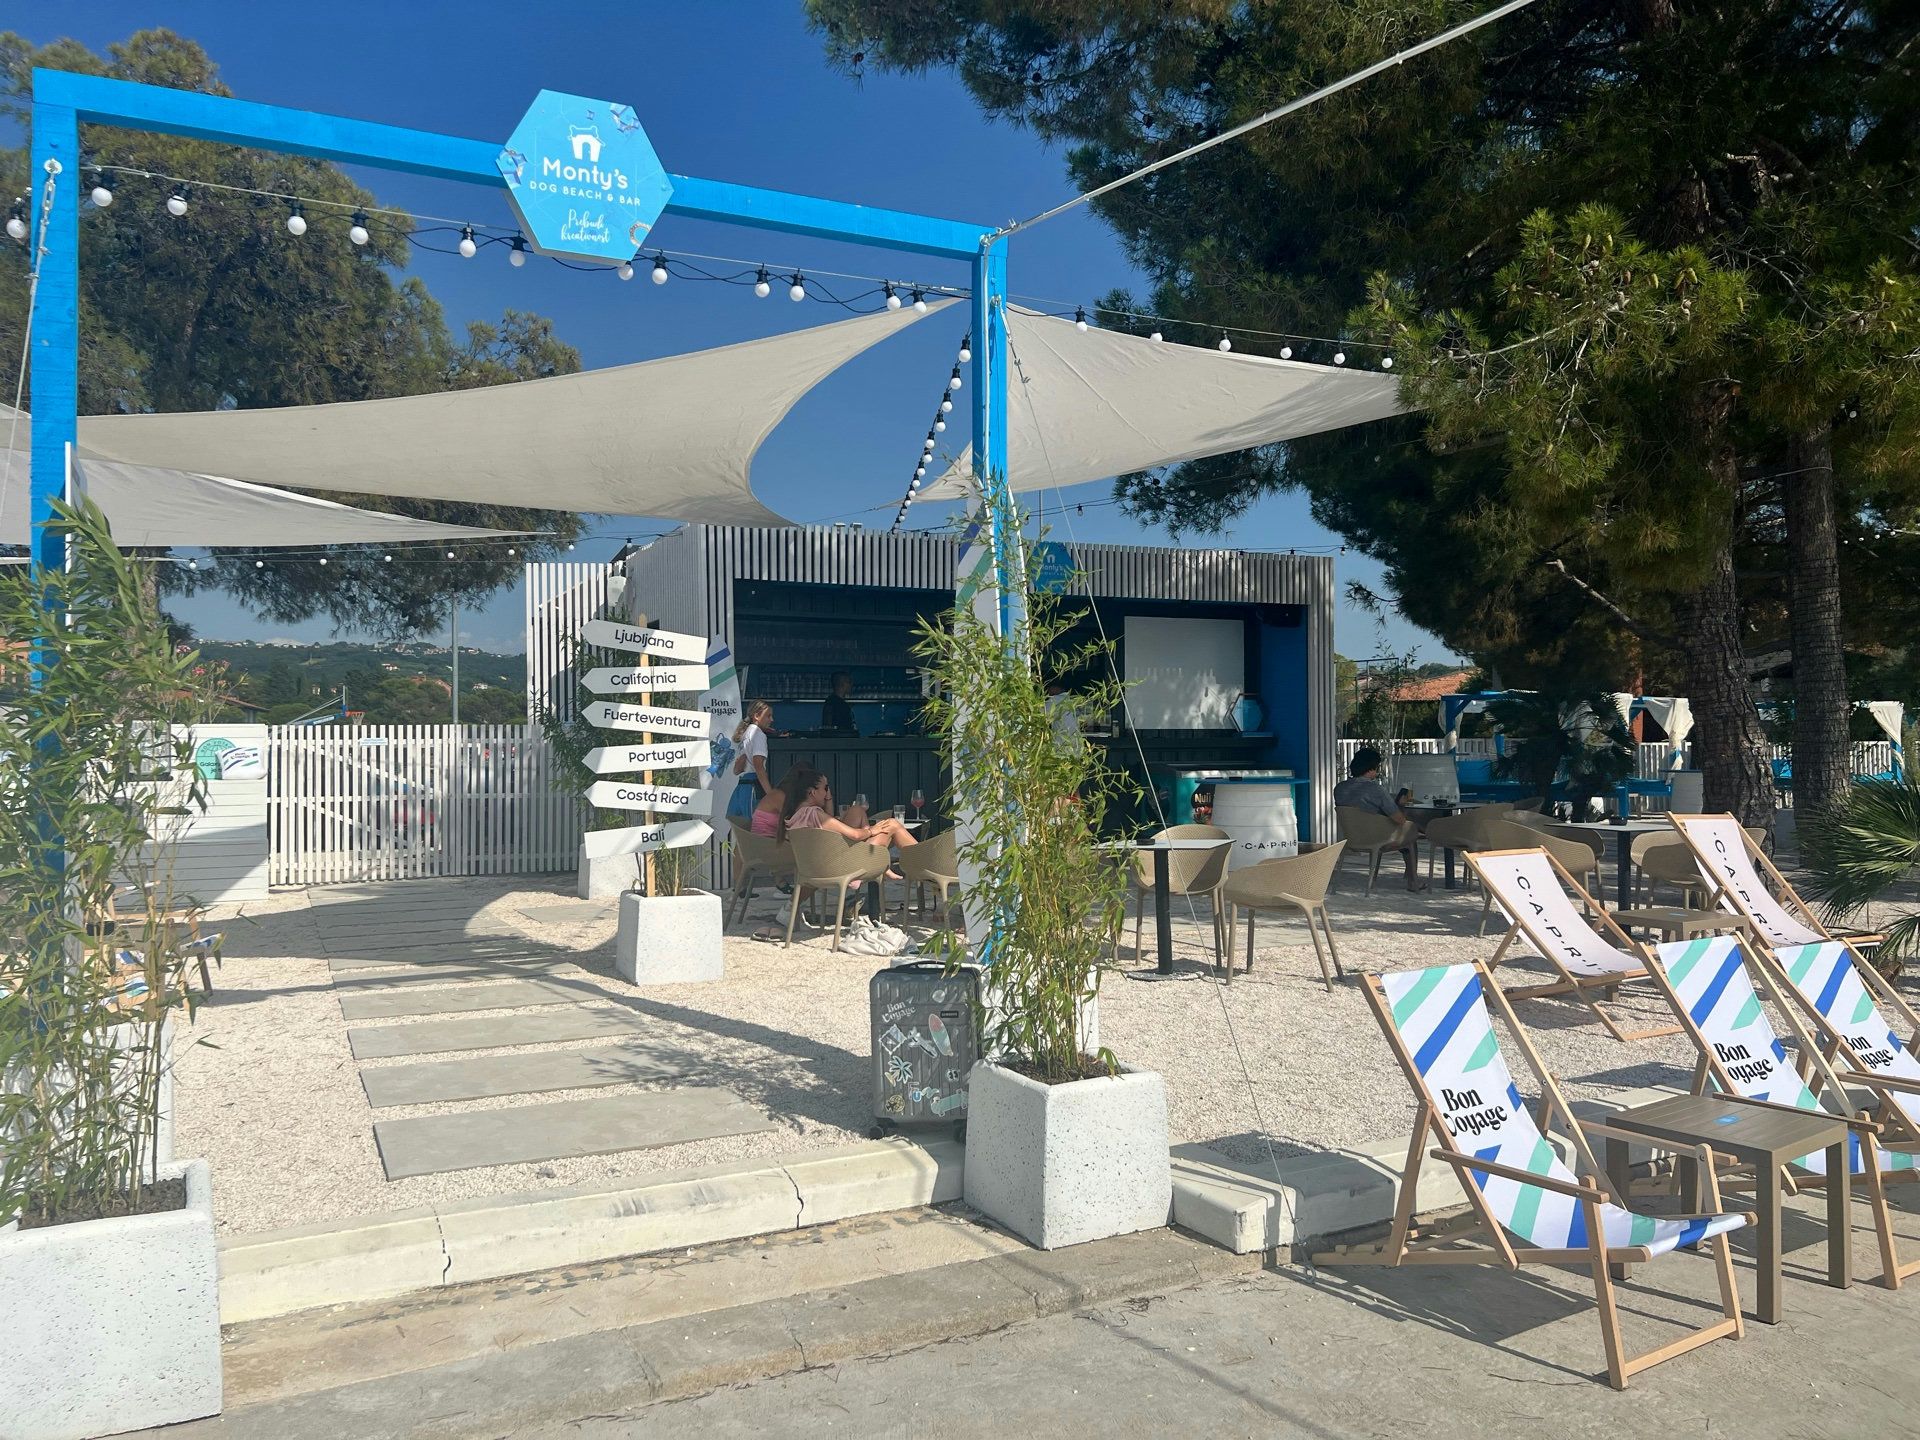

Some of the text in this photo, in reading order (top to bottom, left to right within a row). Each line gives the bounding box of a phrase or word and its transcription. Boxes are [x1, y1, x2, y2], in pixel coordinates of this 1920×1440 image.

[543, 156, 628, 190] Monty's
[529, 180, 557, 193] DOG
[562, 186, 602, 200] BEACH
[619, 195, 641, 206] BAR
[614, 629, 674, 649] Ljubljana
[610, 672, 677, 686] California
[711, 699, 729, 707] Bon
[603, 708, 701, 729] Fuerteventura
[629, 748, 687, 764] Portugal
[616, 789, 689, 805] Costa Rica
[641, 829, 665, 843] Bali
[1713, 1043, 1751, 1062] Bon
[1727, 1059, 1774, 1084] oyage
[1441, 1088, 1484, 1112] Bon
